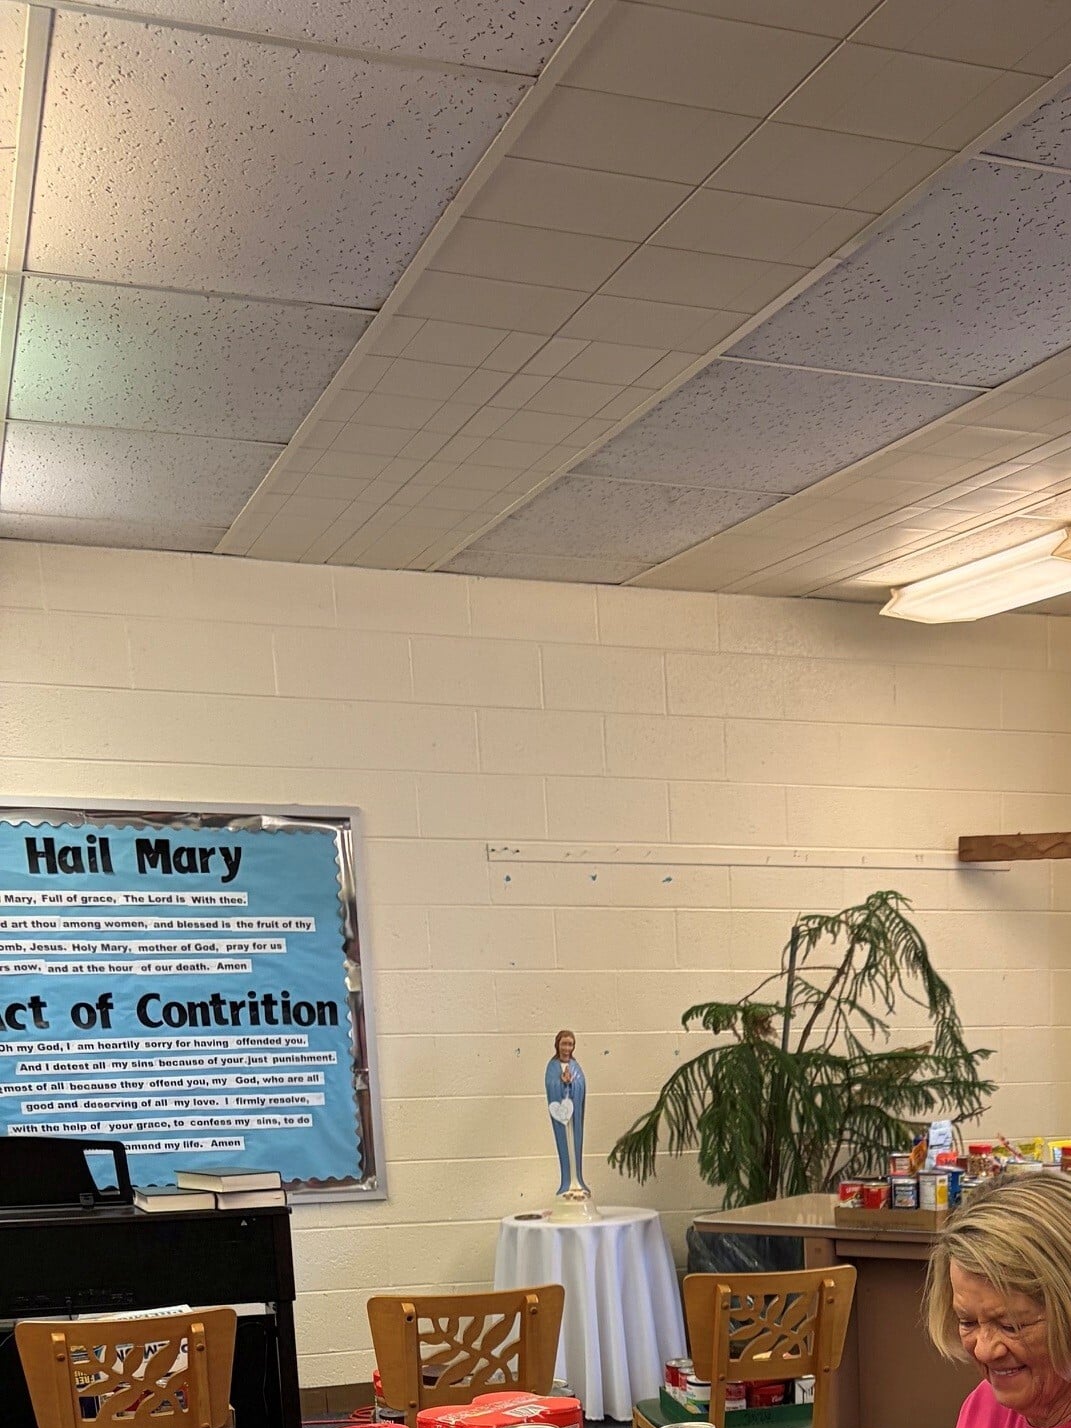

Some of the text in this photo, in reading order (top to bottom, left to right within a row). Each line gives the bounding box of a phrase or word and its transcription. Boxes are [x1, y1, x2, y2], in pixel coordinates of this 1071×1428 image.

[25, 834, 242, 882] Hail Mary
[4, 894, 247, 905] Mary, Full grace, The Lord With thee.
[11, 920, 29, 929] art
[31, 920, 57, 929] thou
[62, 921, 101, 930] among
[104, 921, 148, 930] women,
[153, 920, 174, 929] and
[176, 920, 219, 929] blessed
[236, 920, 254, 929] the
[256, 920, 279, 929] fruit
[295, 920, 312, 931] thy
[29, 942, 267, 954] Jesus. Holy Mary, mother God, pray for
[14, 964, 42, 972] now,
[47, 964, 69, 973] and
[86, 964, 105, 973] the
[108, 964, 133, 972] hour
[175, 963, 210, 972] death.
[216, 962, 247, 971] Amen
[0, 991, 338, 1031] ct of Contrition
[36, 1037, 306, 1052] God, heartily sorry for having offended you.
[19, 1054, 336, 1072] And detest sins because your just punishment.
[69, 1081, 117, 1091] because
[120, 1080, 145, 1090] they
[149, 1078, 184, 1088] offend
[186, 1079, 209, 1088] you,
[235, 1076, 260, 1085] God,
[262, 1075, 285, 1084] who
[287, 1075, 304, 1083] are
[306, 1074, 320, 1082] all
[25, 1101, 54, 1112] good
[57, 1100, 78, 1109] and
[154, 1099, 168, 1107] all
[193, 1097, 219, 1106] love.
[235, 1096, 266, 1107] firmly
[12, 1124, 38, 1134] with
[41, 1123, 59, 1132] the
[62, 1122, 87, 1133] help
[108, 1122, 133, 1131] your
[183, 1139, 241, 1149] life. Amen
